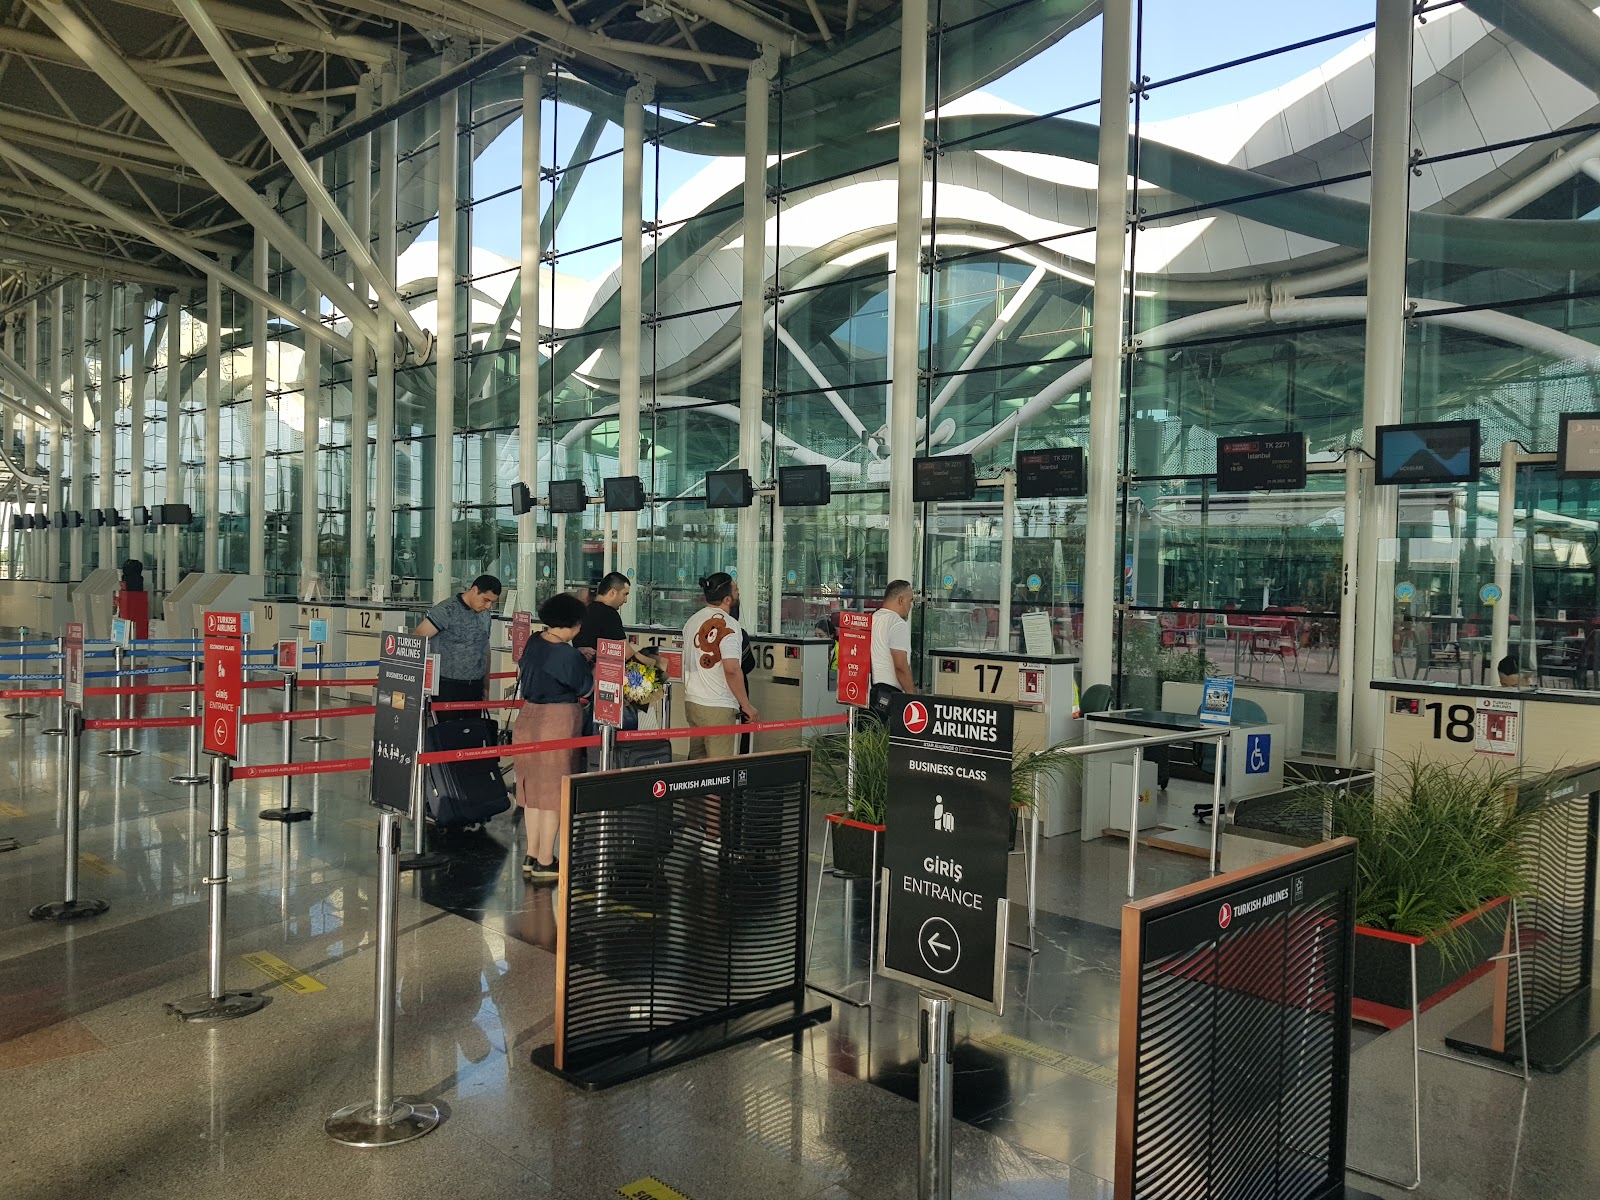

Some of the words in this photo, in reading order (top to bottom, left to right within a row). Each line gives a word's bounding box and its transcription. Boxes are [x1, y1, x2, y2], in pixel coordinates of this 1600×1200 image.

[217, 615, 236, 625] TURKISH
[264, 605, 273, 620] 10
[311, 607, 319, 619] 11
[360, 611, 370, 628] 12
[851, 614, 869, 622] TURKISH
[217, 624, 236, 633] AIRLINES
[397, 636, 422, 649] TURKISH
[396, 646, 421, 659] AIRLINES
[753, 644, 775, 670] 16
[116, 667, 170, 676] ANADOLUJET
[973, 664, 1003, 694] 17
[209, 700, 234, 712] ENTRANCE
[933, 703, 998, 726] TURKISH
[1425, 702, 1475, 743] 18
[932, 720, 998, 743] AIRLINES
[279, 765, 300, 773] AIRLINES
[909, 759, 954, 777] BUSINESS
[955, 767, 987, 782] CLASS
[669, 779, 700, 792] TURKISH
[700, 775, 731, 788] AIRLINES
[923, 855, 963, 883] GİRİŞ
[903, 875, 983, 911] ENTRANCE
[1233, 900, 1262, 918] TURKISH
[1261, 888, 1289, 908] AIRLINES
